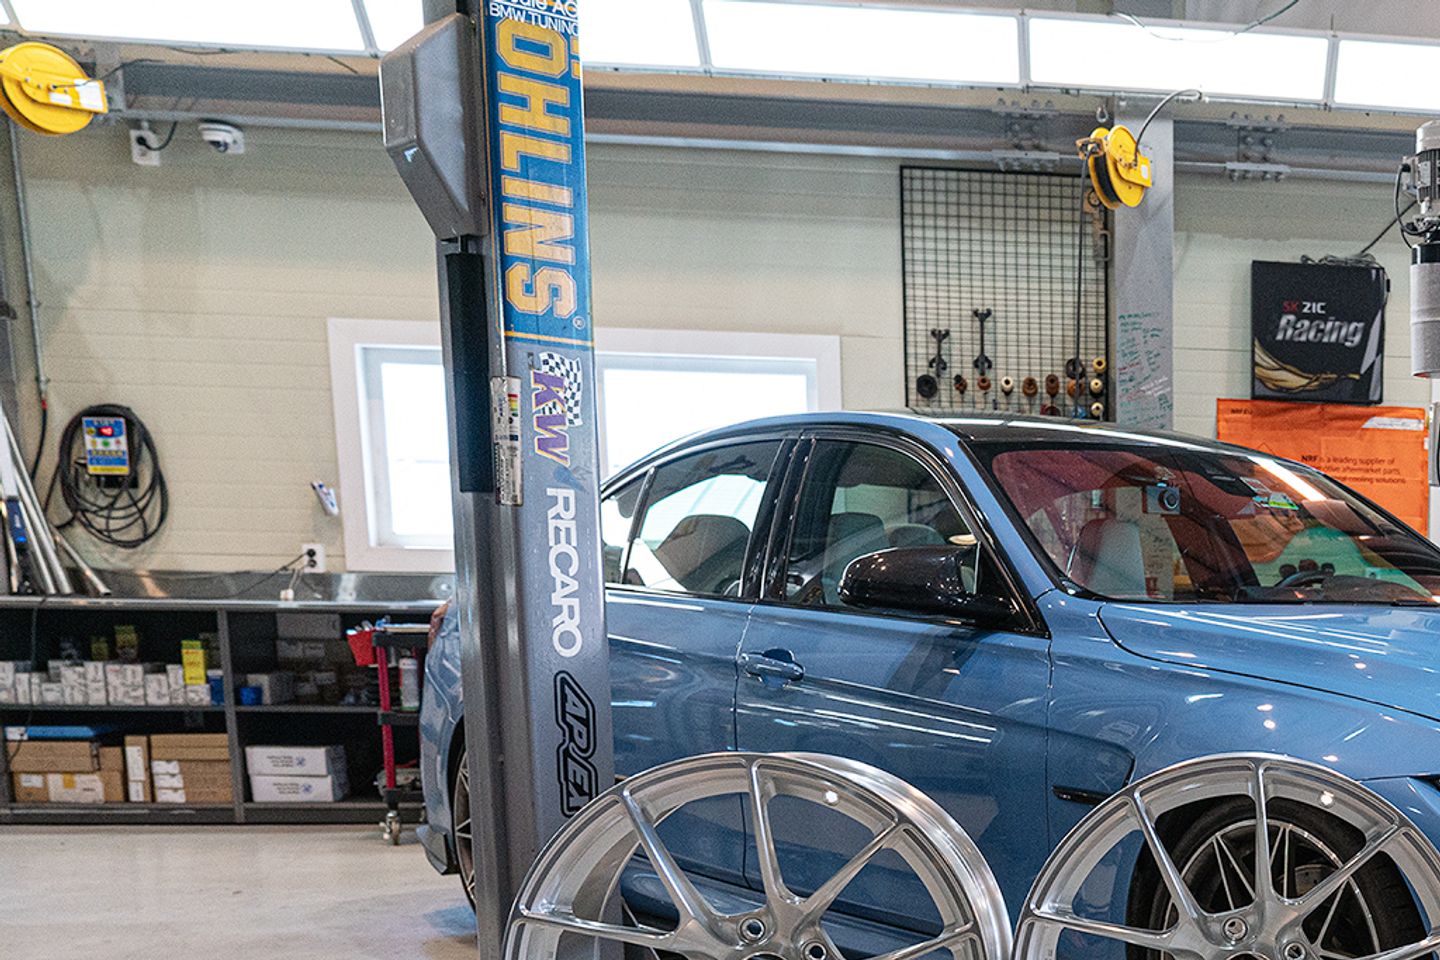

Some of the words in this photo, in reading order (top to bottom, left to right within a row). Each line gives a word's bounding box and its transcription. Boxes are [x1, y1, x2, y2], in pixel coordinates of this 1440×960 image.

[490, 2, 526, 23] BMW
[1302, 301, 1326, 314] ZIC
[1275, 314, 1365, 348] Racing
[531, 369, 571, 467] KW
[1302, 455, 1318, 463] NRF
[1333, 456, 1358, 466] leading
[1359, 457, 1385, 466] supplier
[1342, 466, 1381, 474] aftermarket
[547, 487, 583, 658] RECARO
